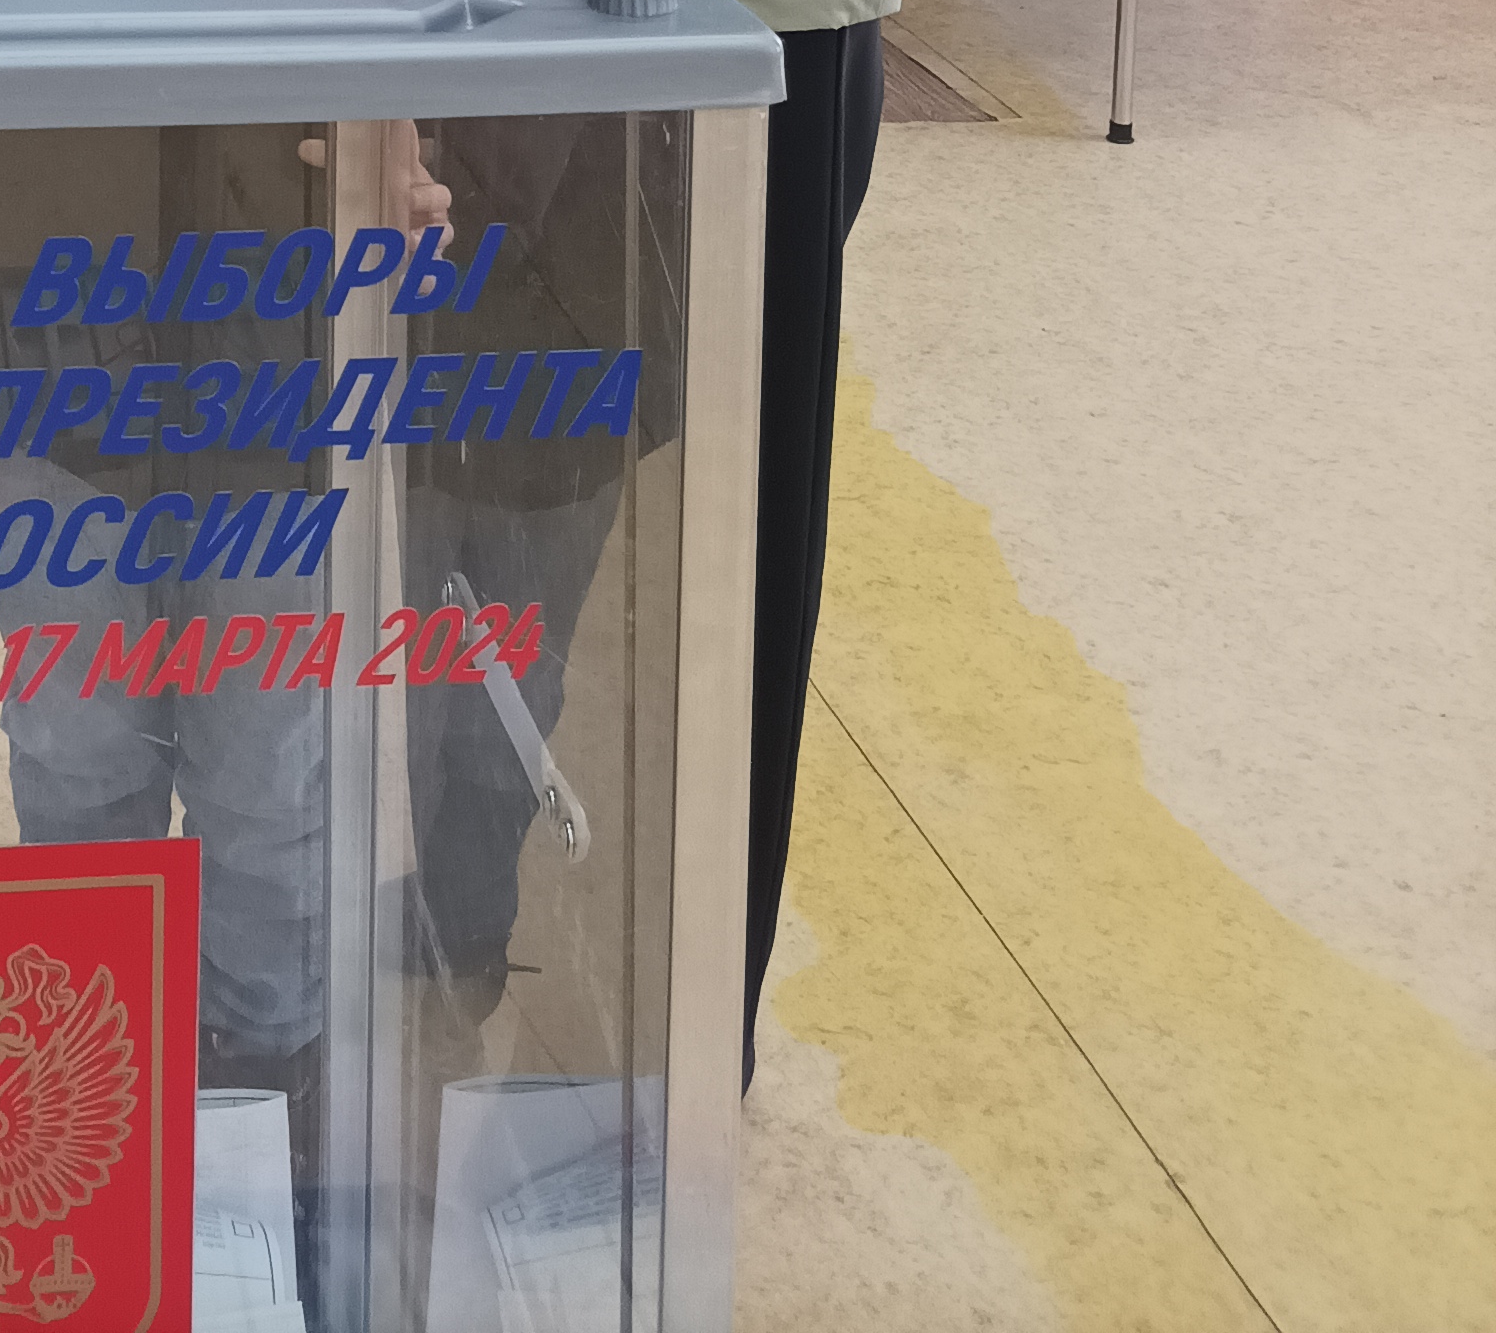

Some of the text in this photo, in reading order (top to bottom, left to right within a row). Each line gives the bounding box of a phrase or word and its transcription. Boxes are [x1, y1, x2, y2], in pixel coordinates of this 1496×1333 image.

[11, 222, 507, 327] ВЫБОРЫ
[78, 613, 342, 700] МАРТА
[356, 601, 544, 687] 2024
